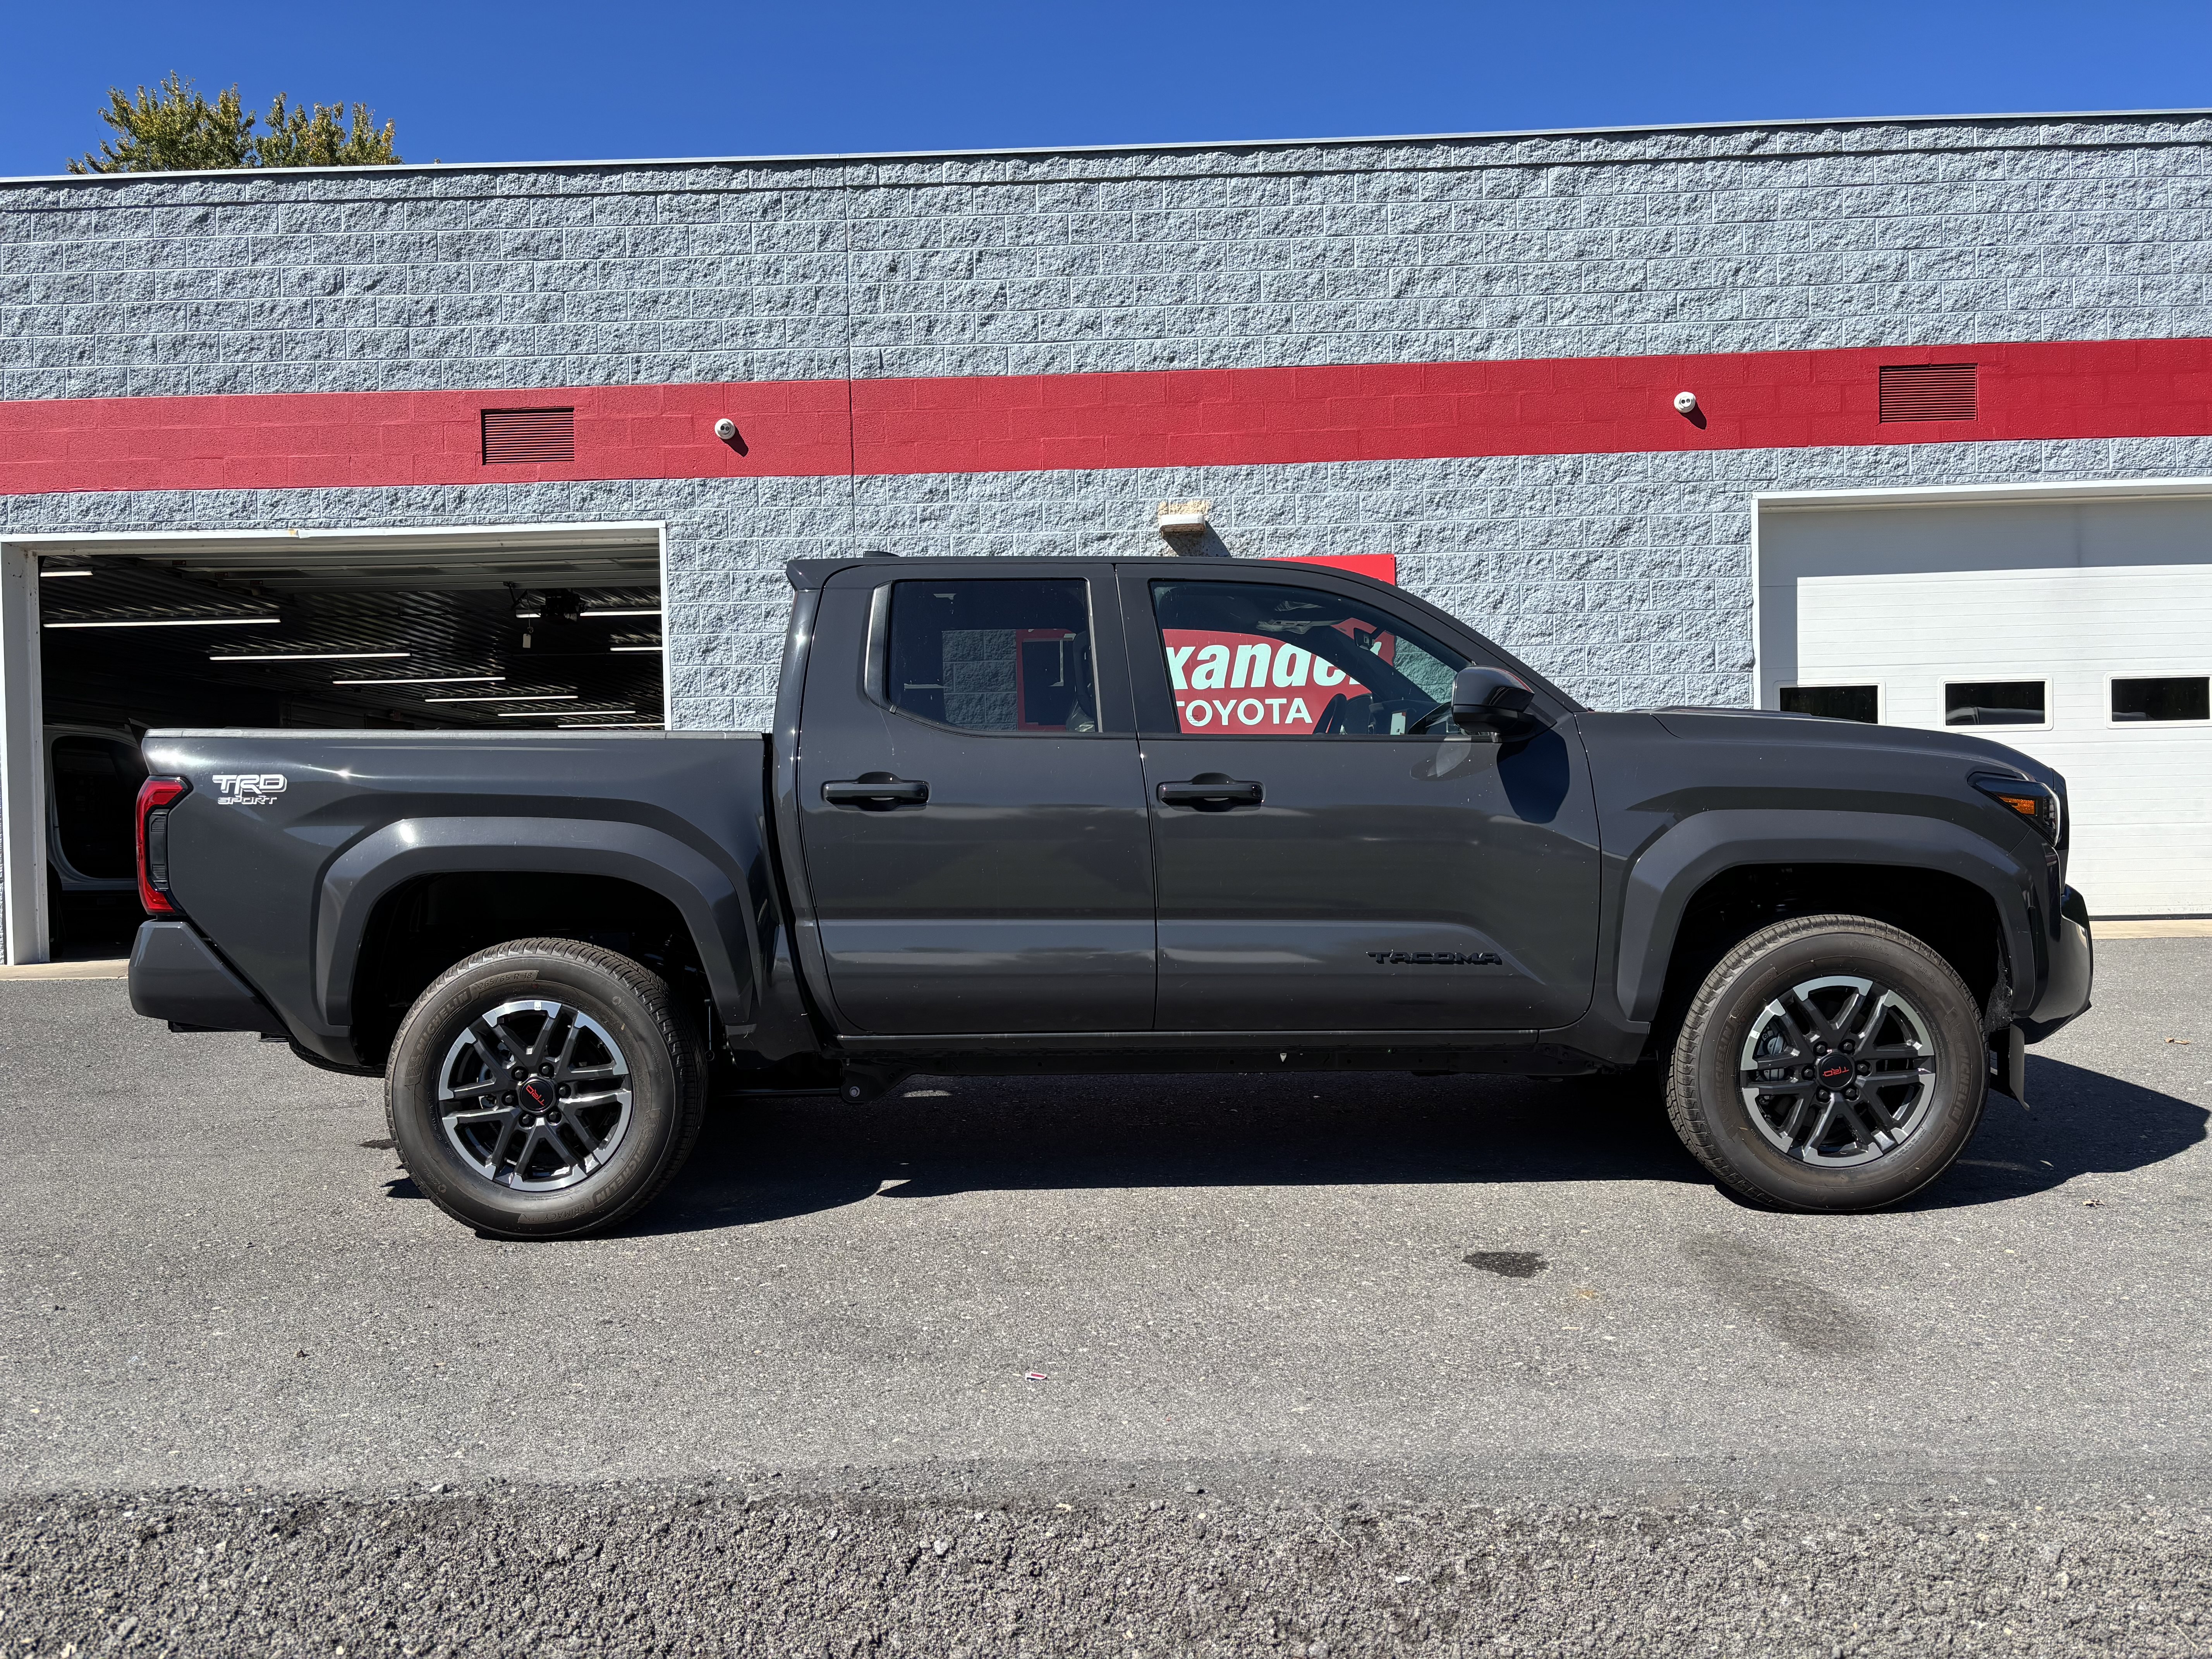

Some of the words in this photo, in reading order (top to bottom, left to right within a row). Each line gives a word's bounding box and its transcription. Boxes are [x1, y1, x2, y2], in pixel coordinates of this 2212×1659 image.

[212, 774, 287, 795] TRD
[218, 796, 278, 805] SPORT
[1366, 951, 1503, 965] TACOMA
[479, 974, 510, 989] 265/65
[417, 991, 469, 1053] MICHELIN
[1715, 1027, 1733, 1101] MICHELIN
[1824, 1066, 1850, 1077] TRD
[1954, 1045, 1970, 1121] MICHELIN
[526, 1085, 544, 1106] TRD
[596, 1142, 648, 1203] MICHELIN
[544, 1204, 586, 1221] PRIMACY
